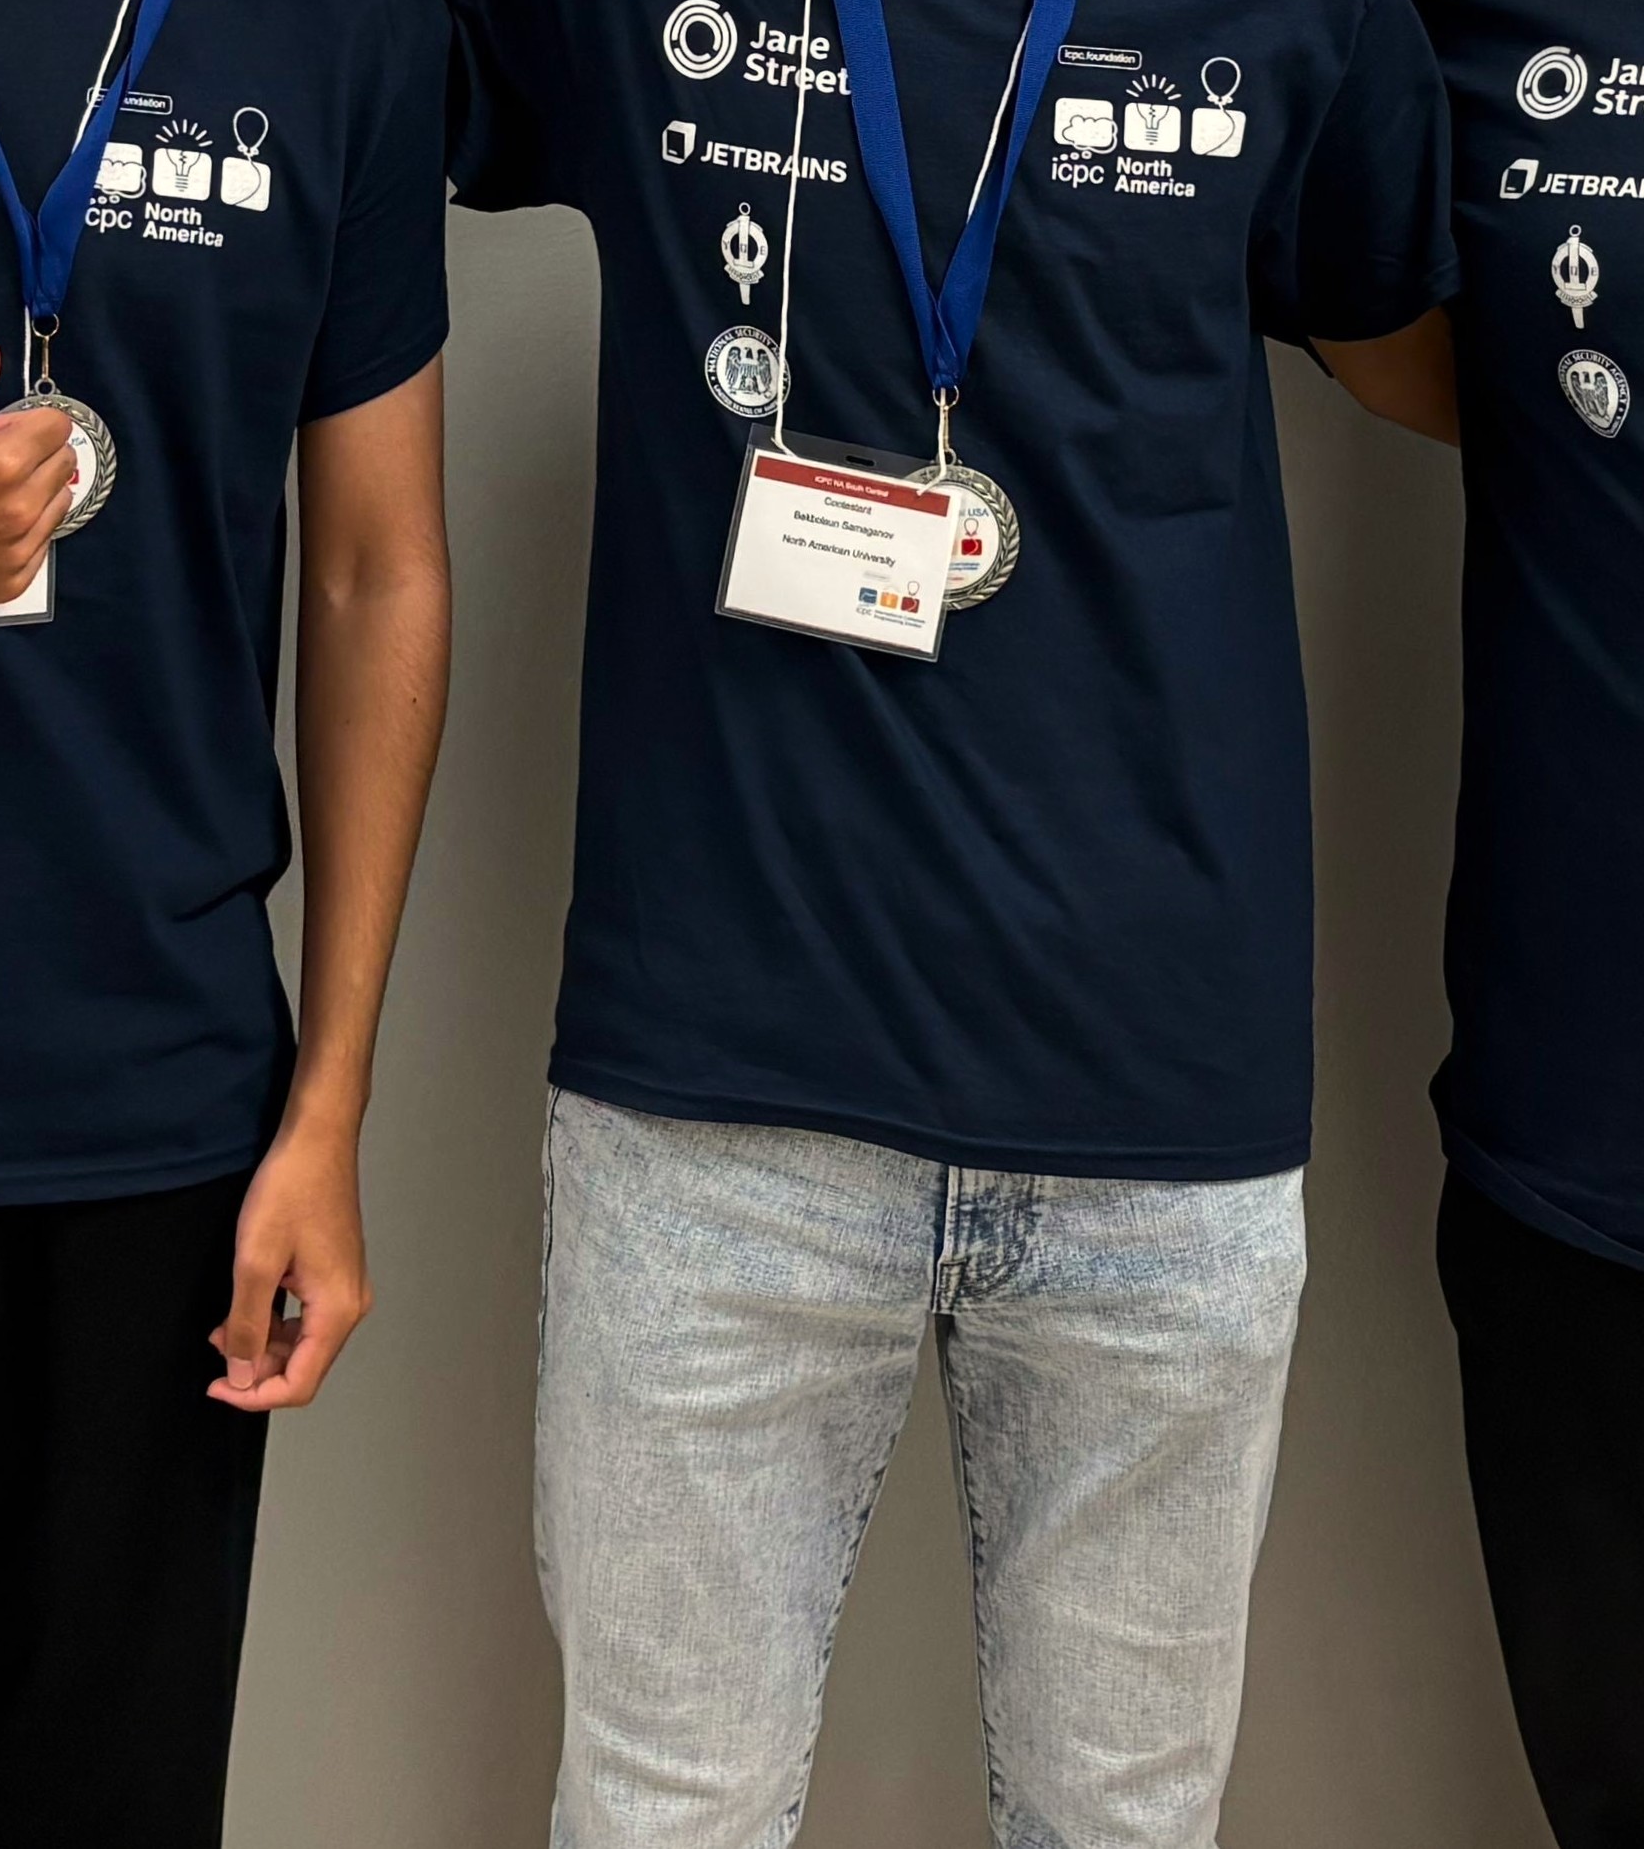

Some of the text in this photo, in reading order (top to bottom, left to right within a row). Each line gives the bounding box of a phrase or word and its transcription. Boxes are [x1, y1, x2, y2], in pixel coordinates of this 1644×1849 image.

[1064, 49, 1136, 64] icpc.foundation
[743, 53, 852, 96] Street
[700, 141, 847, 183] JETBRAINS
[1051, 157, 1104, 189] icpc
[1116, 156, 1172, 177] North
[1114, 174, 1195, 198] America
[85, 207, 133, 233] cpc
[144, 201, 202, 226] North
[142, 220, 224, 248] America
[708, 328, 771, 373] NATIONAL SECURITY
[1572, 352, 1627, 403] SECURITY AGENCY
[824, 496, 872, 515] Contestant
[968, 508, 989, 517] USA
[782, 534, 896, 568] North American University
